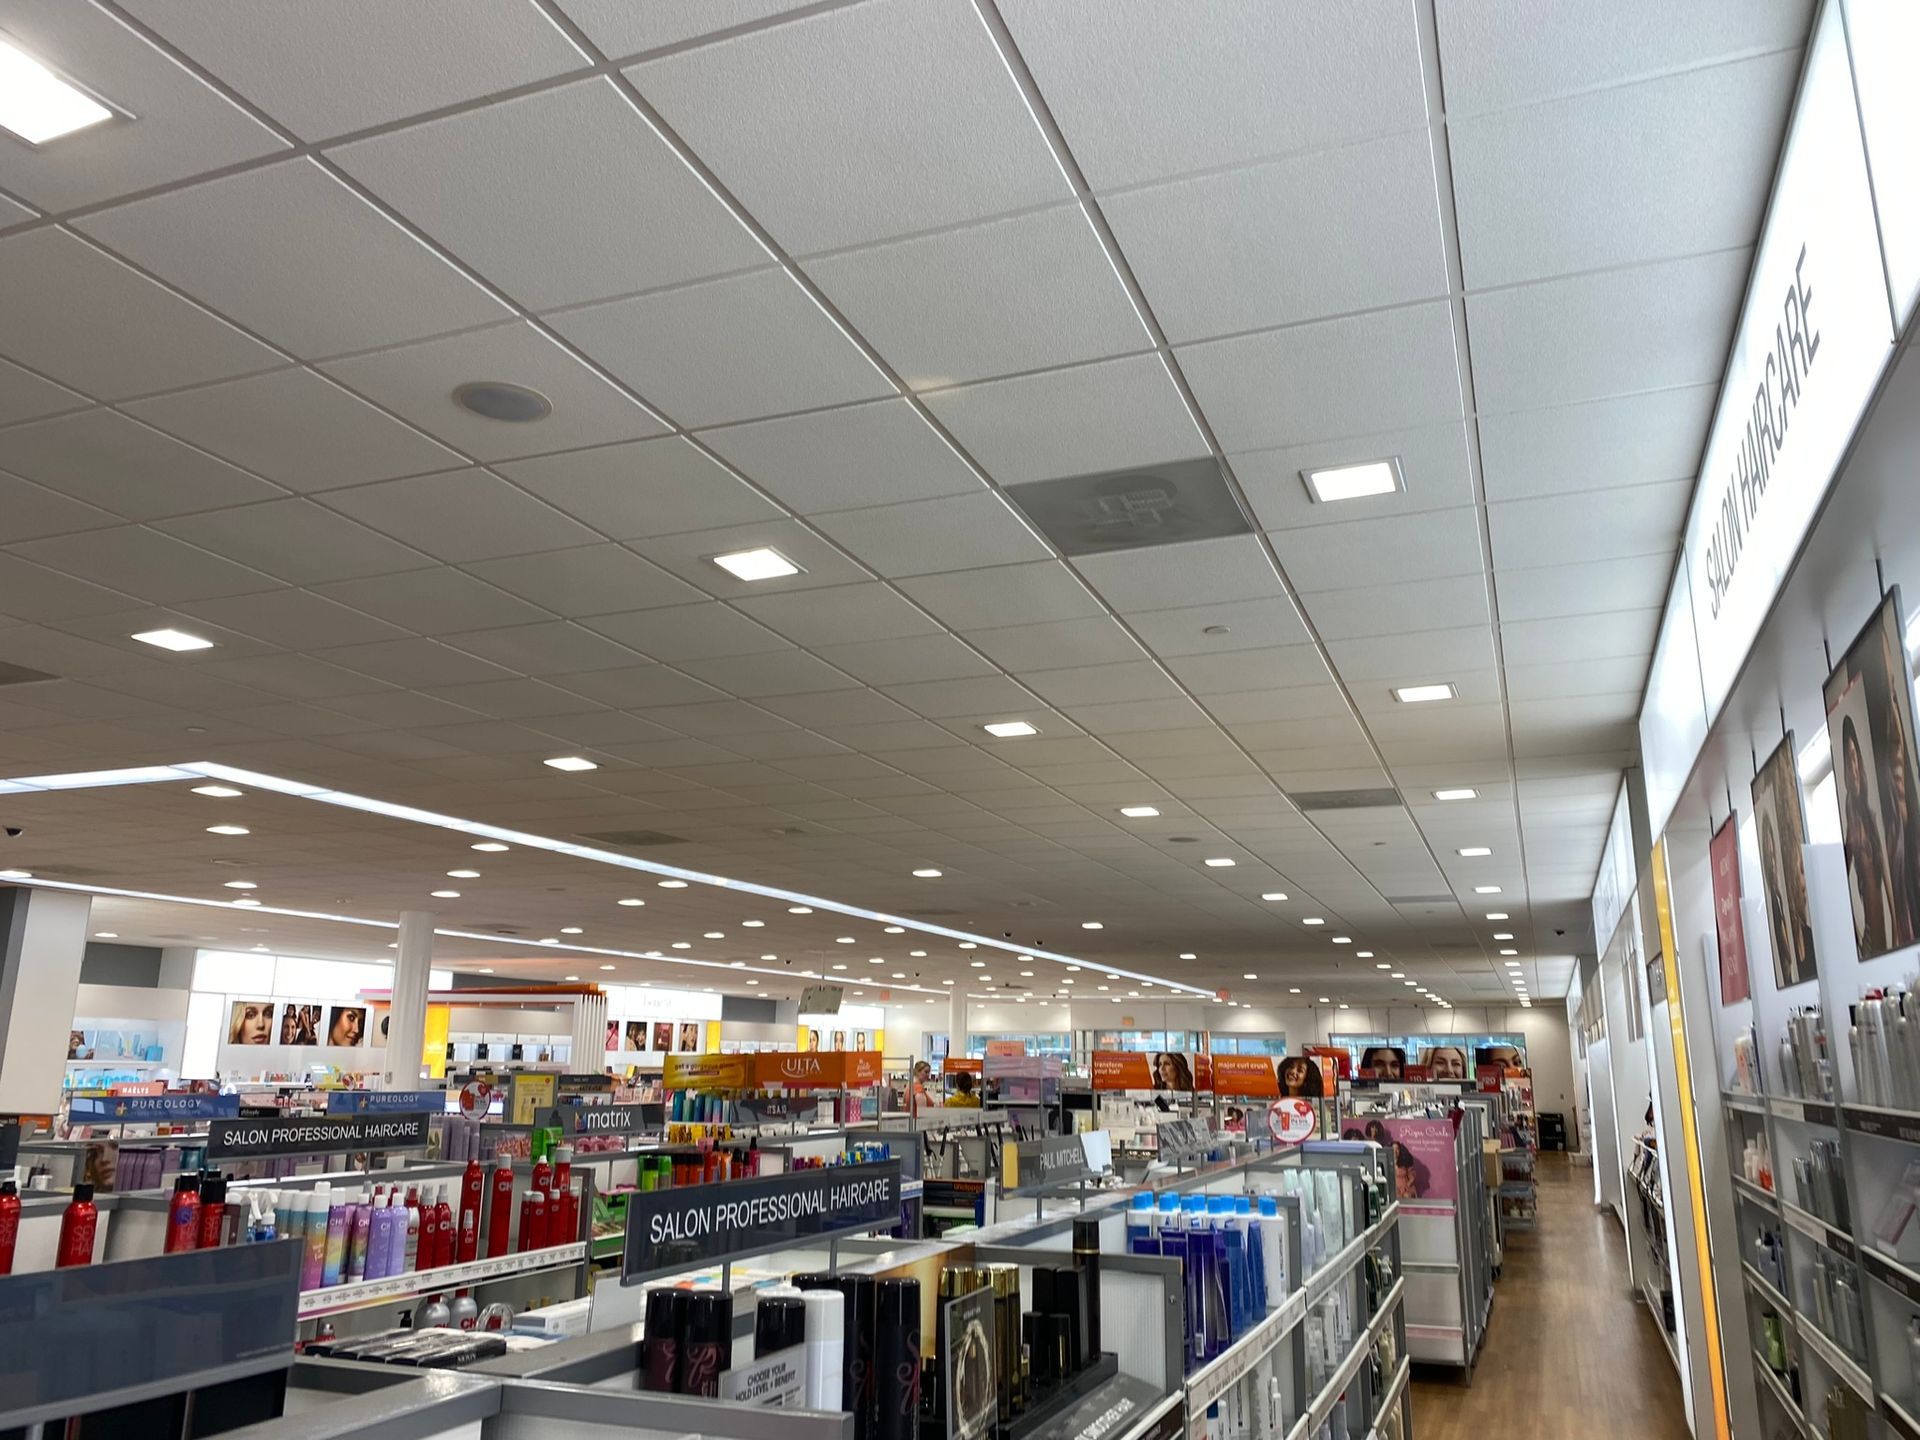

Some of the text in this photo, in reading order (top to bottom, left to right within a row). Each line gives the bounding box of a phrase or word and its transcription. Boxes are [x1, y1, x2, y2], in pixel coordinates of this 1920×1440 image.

[1705, 241, 1820, 620] SALON HAIRCARE
[786, 1058, 820, 1072] ULTA
[122, 1086, 149, 1095] MAËLYS
[131, 1099, 201, 1109] PUREOLOGY
[587, 1108, 630, 1128] matrix
[224, 1122, 419, 1146] SALON PROFESSIONAL HAIRCARE
[1040, 1147, 1083, 1171] PAUL MITCHELL
[650, 1178, 890, 1244] SALON PROFESSIONAL HAIRCARE
[460, 1317, 477, 1330] CH
[748, 1362, 786, 1386] CHOOSE YOUR
[753, 1382, 769, 1397] LEVEL
[775, 1369, 796, 1388] BENEFIT
